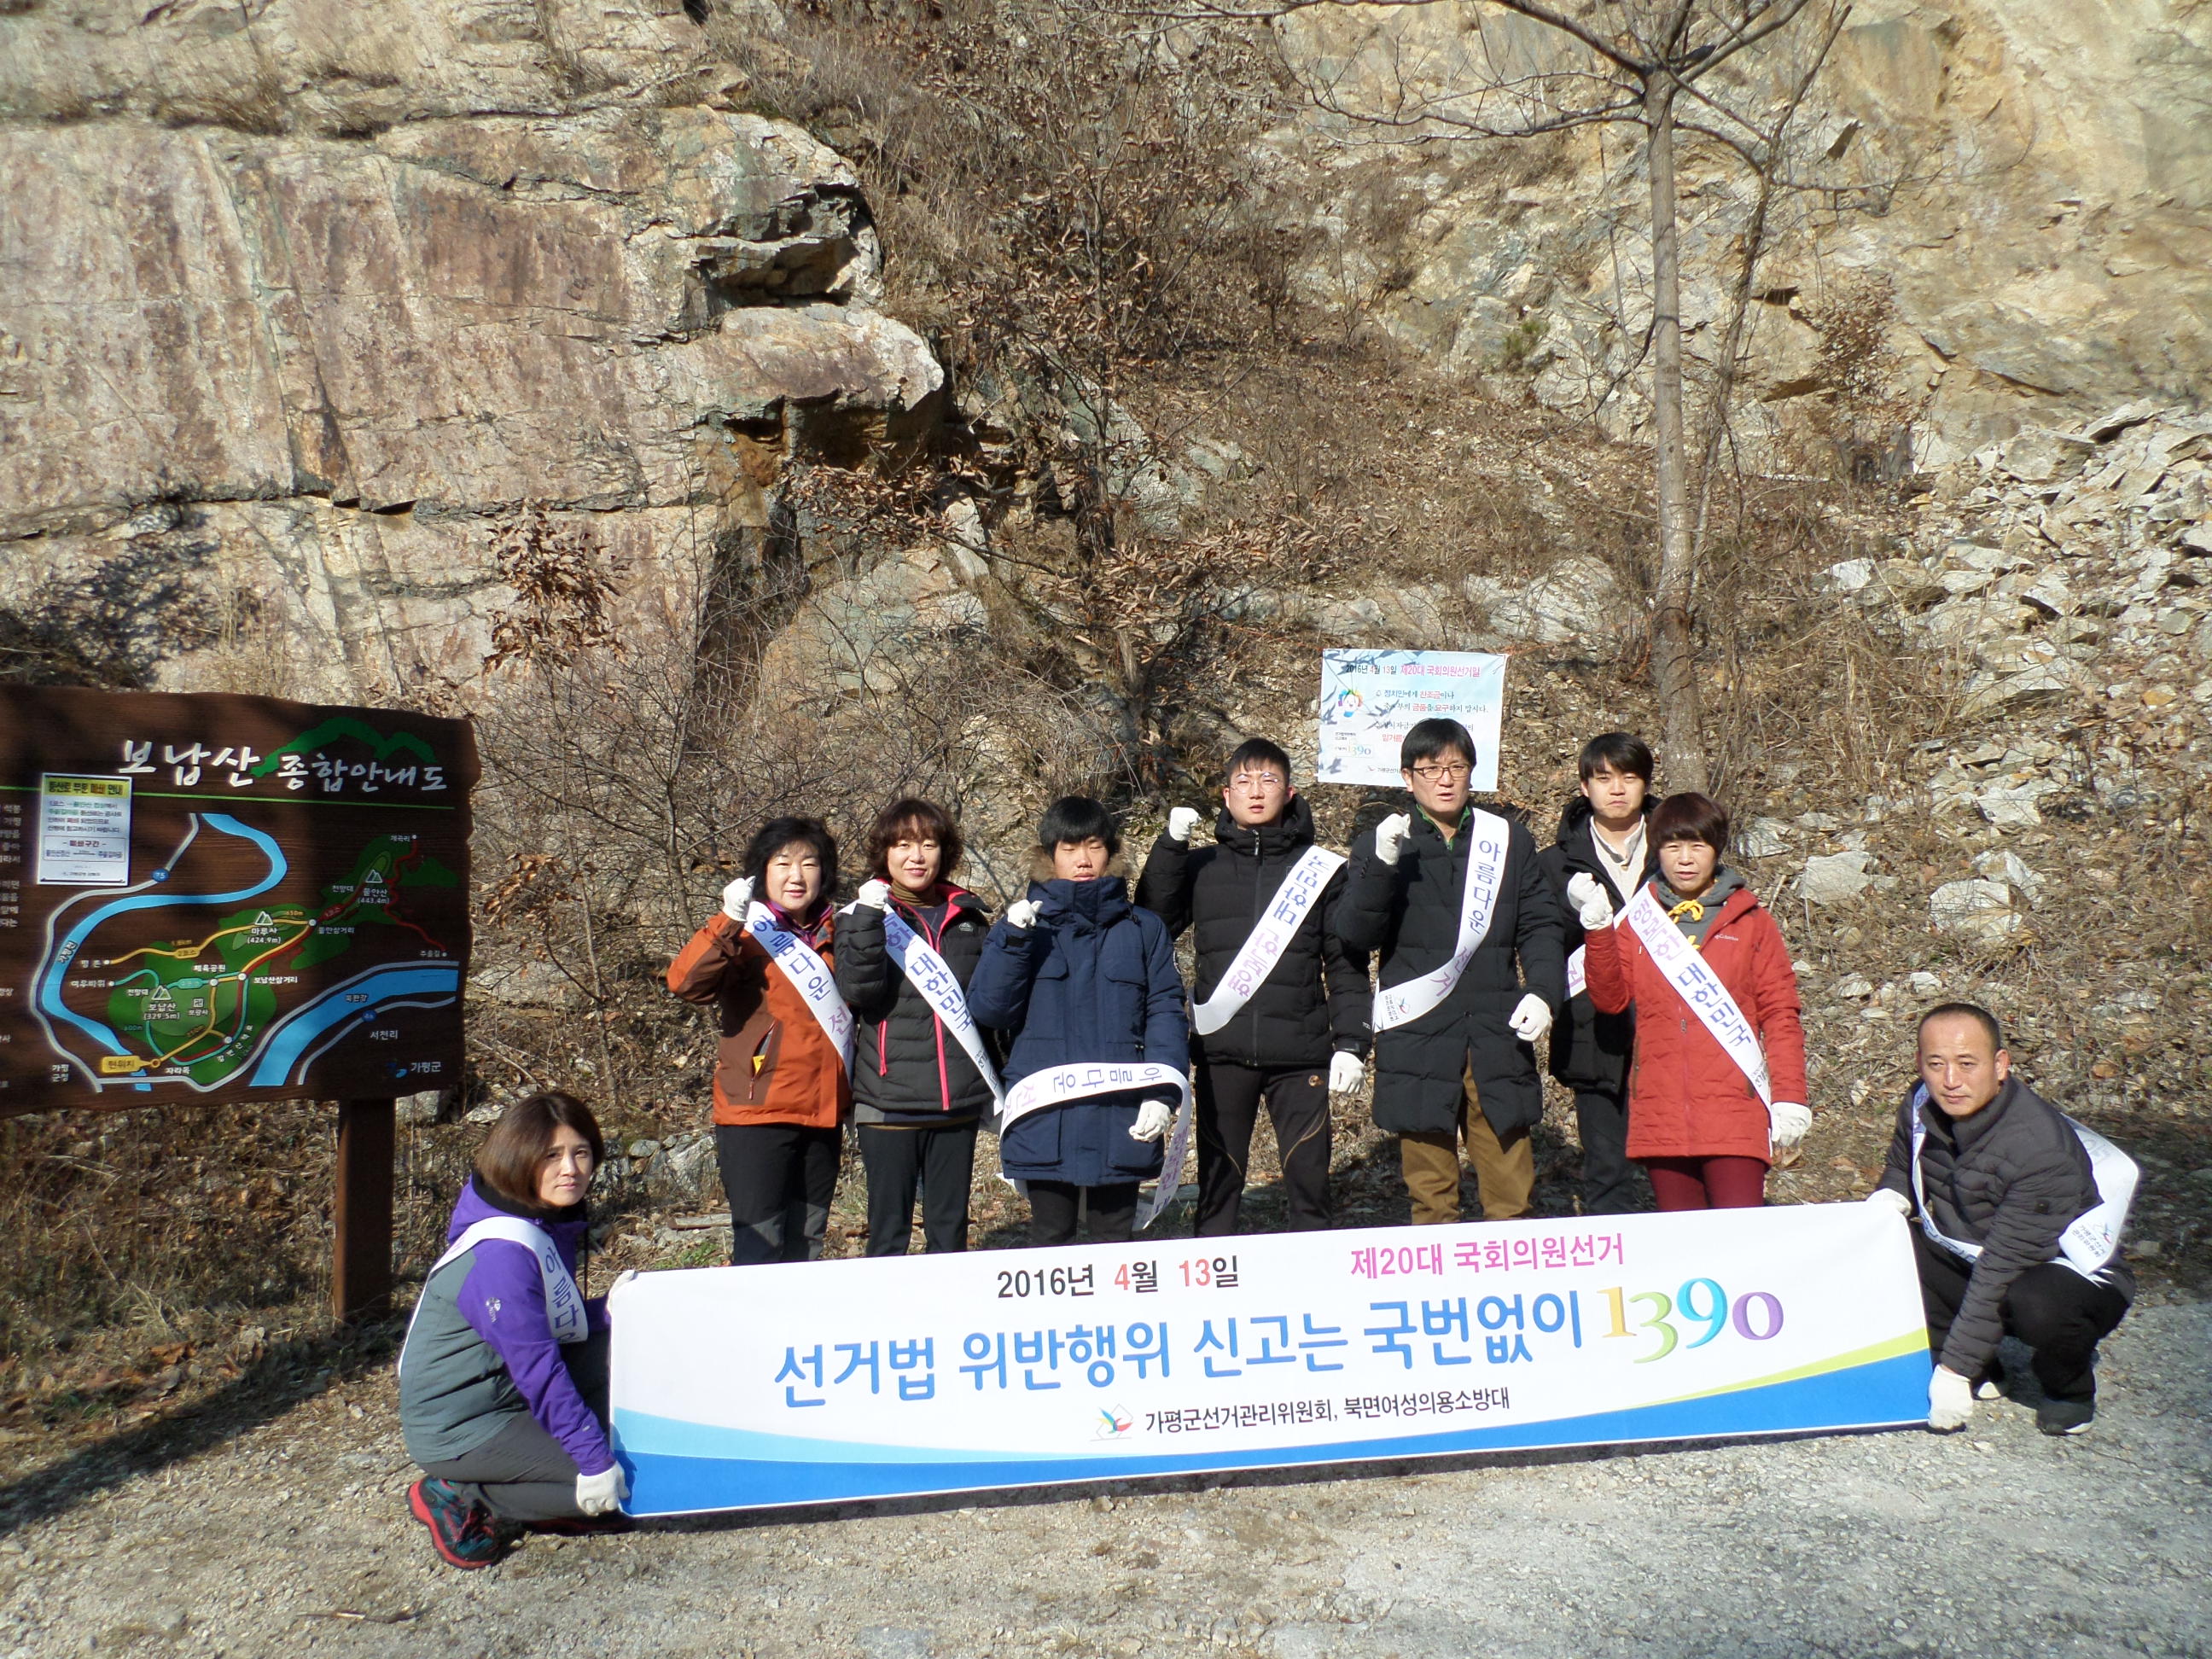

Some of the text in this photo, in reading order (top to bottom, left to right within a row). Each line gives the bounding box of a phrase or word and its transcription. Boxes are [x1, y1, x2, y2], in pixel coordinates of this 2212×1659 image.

[1384, 689, 1418, 699] 정치인에게
[1400, 665, 1425, 676] 제20대
[119, 740, 447, 792] 보납산 종합안내도
[1470, 840, 1502, 935] 아름다운
[1227, 855, 1330, 998] 행복한 대한민국
[753, 915, 831, 1002] 아름다운
[1632, 898, 1752, 1047] 행복한 대한민국
[148, 1002, 177, 1012] 보납산
[911, 952, 975, 1033] 대한민국
[370, 1029, 399, 1039] 서천리
[410, 1061, 442, 1073] 가평군
[997, 1232, 1625, 1300] 2016년 4월 13일 제20대 국회의원선거
[774, 1277, 1784, 1409] 선거법 위반행위 신고는 국번없이 1390
[1146, 1385, 1511, 1435] 가평군선거관리위원회, 북면여성의용소방대
